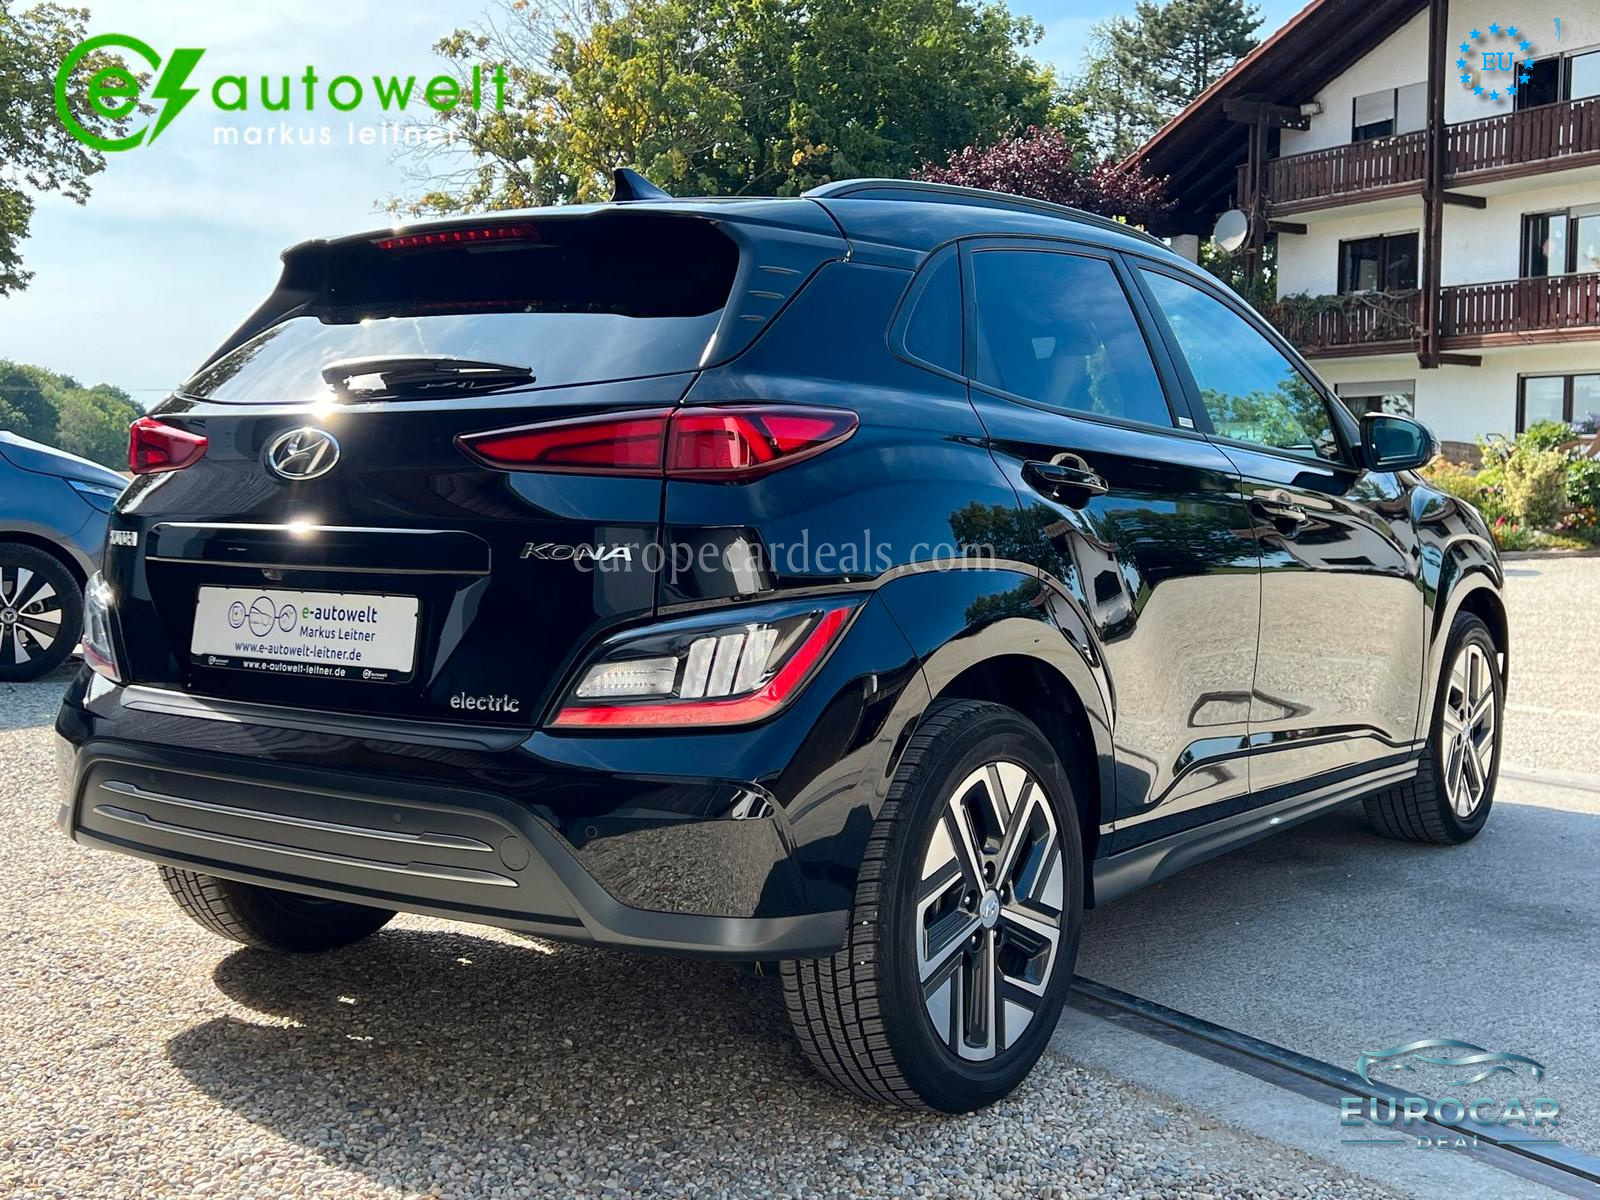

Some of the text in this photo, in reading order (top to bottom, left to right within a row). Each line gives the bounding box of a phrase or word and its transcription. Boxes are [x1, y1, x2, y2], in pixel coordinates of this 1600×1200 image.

[520, 542, 633, 562] KONA
[301, 605, 378, 624] e-autowelt
[299, 626, 376, 642] Markus Leitner
[234, 641, 362, 662] www.e-autowelt-leitner.de
[242, 660, 346, 678] www.e-autowelt-leitner.de
[450, 690, 520, 713] electric
